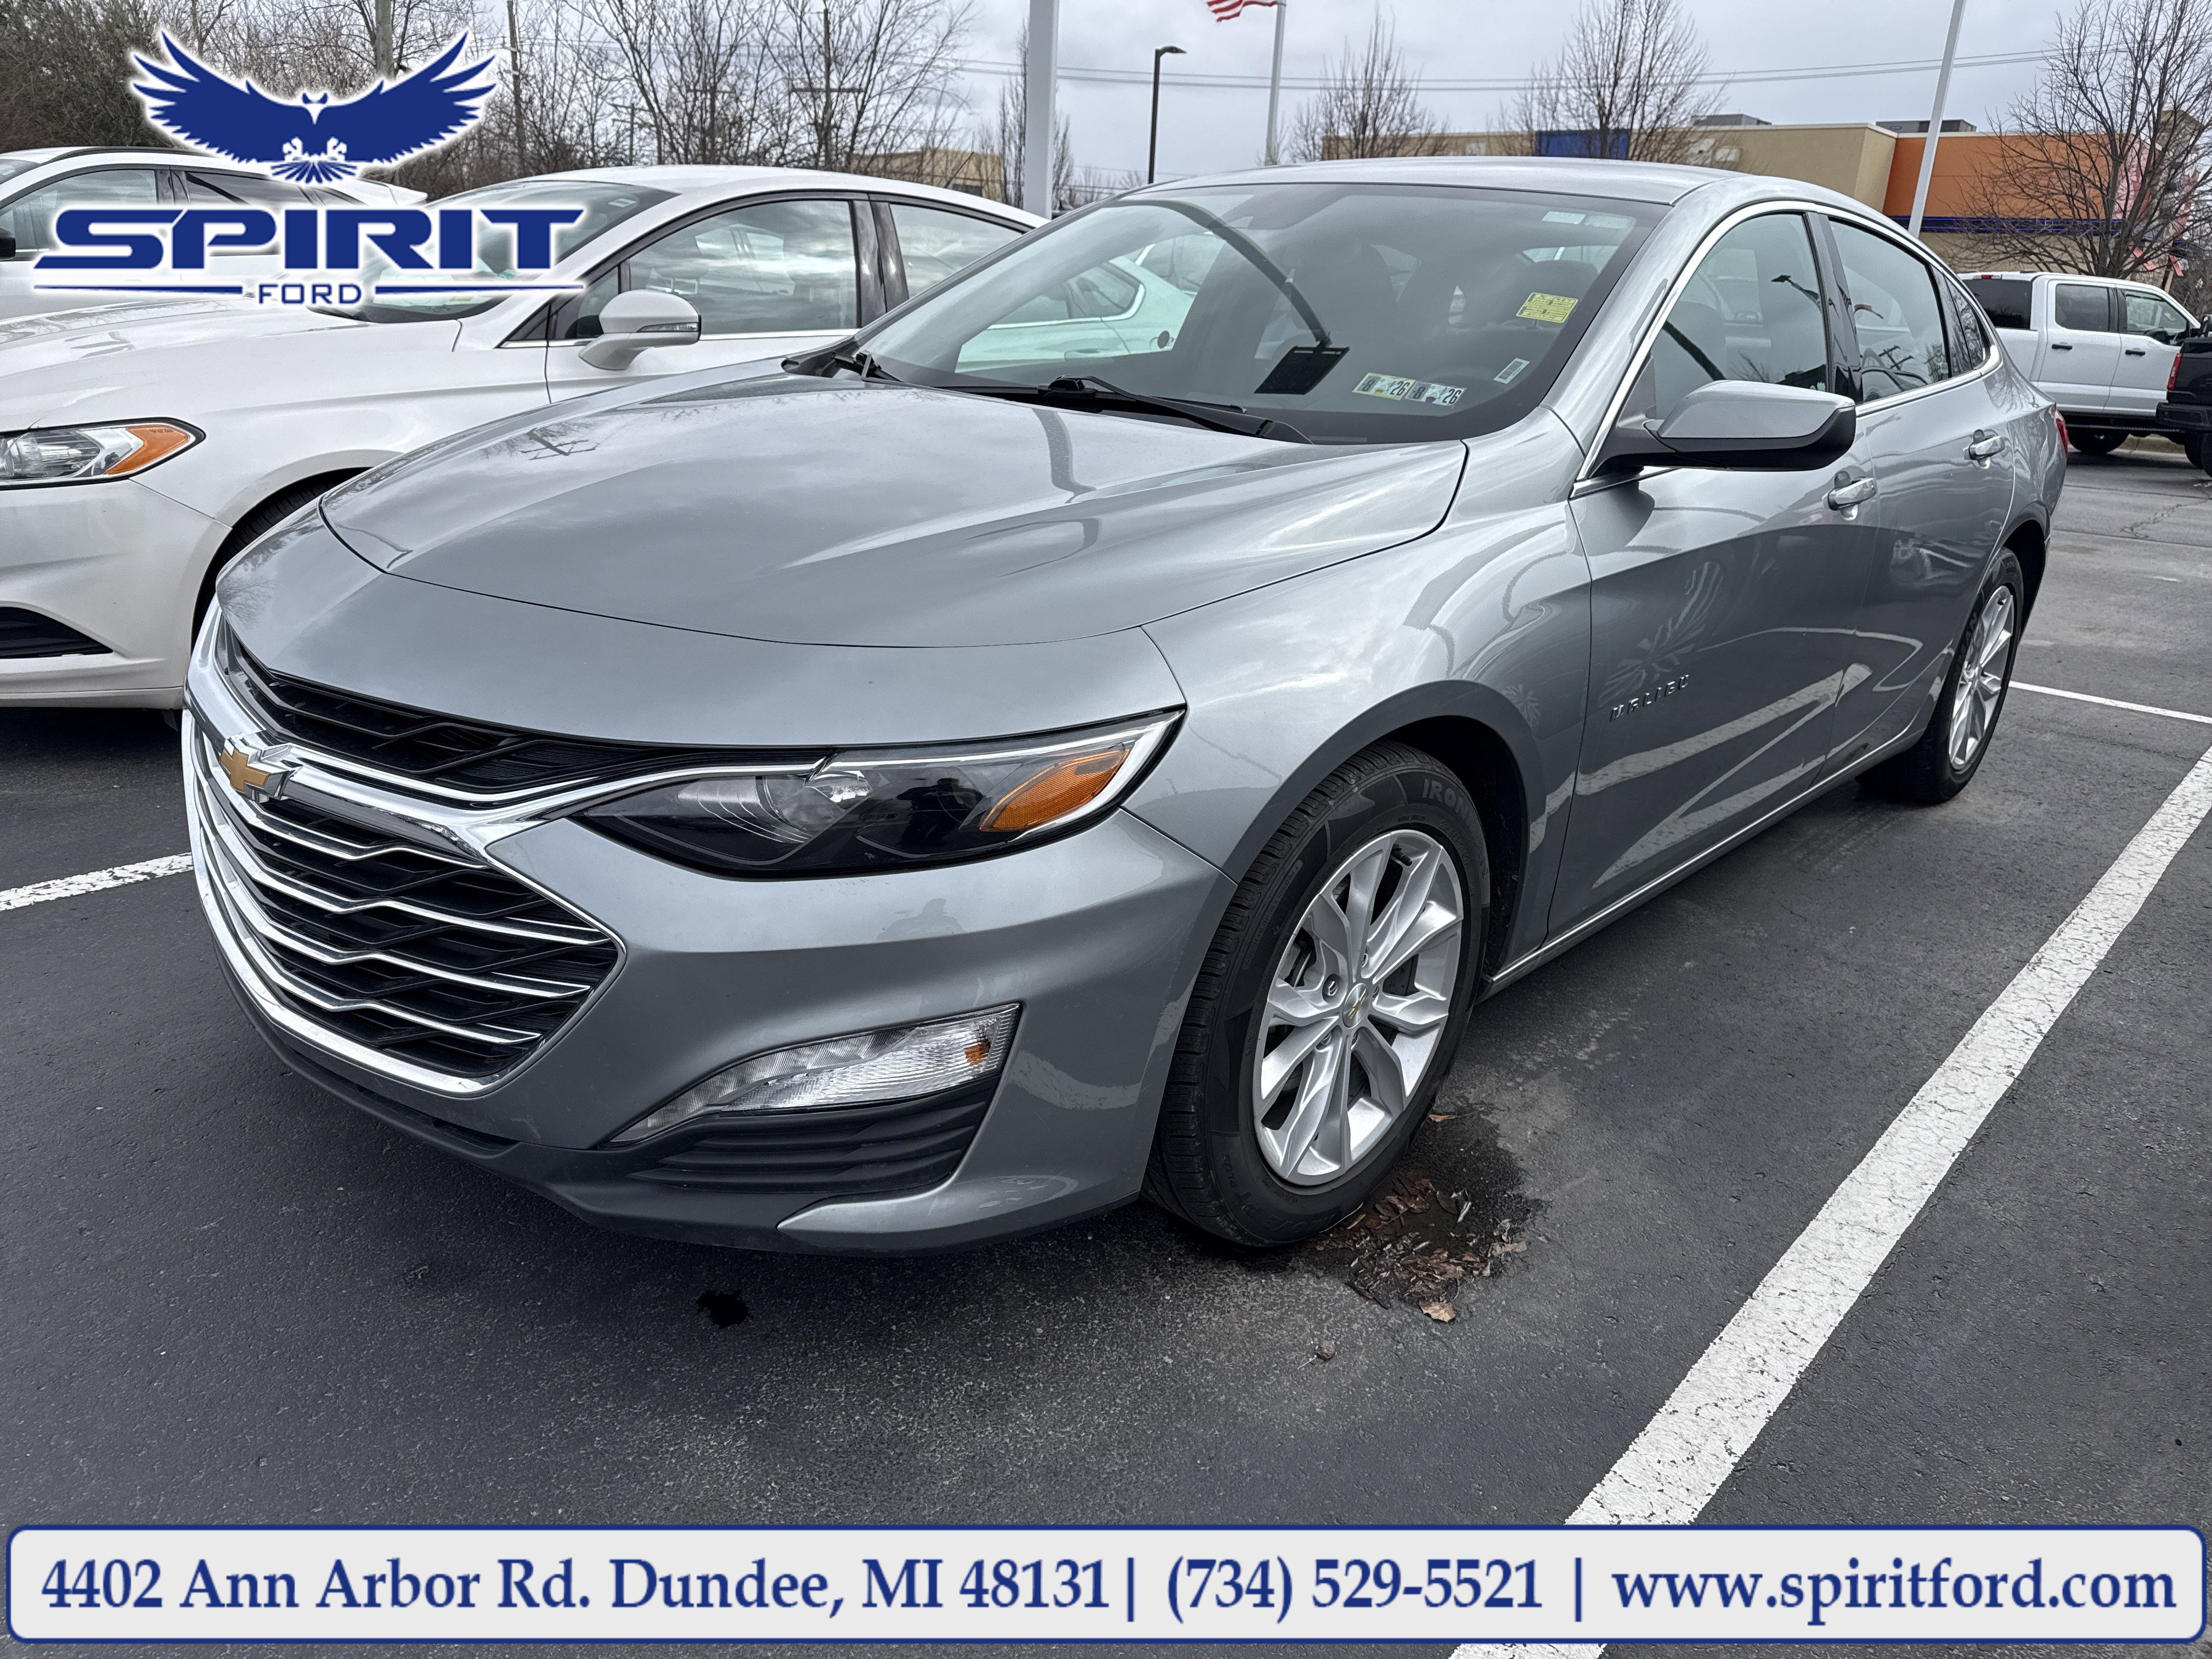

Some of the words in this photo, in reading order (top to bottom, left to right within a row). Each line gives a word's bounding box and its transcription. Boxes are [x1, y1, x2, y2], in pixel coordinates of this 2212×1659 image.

[1389, 381, 1410, 396] 26
[1442, 388, 1462, 404] 26
[1610, 674, 1690, 723] MALIBU
